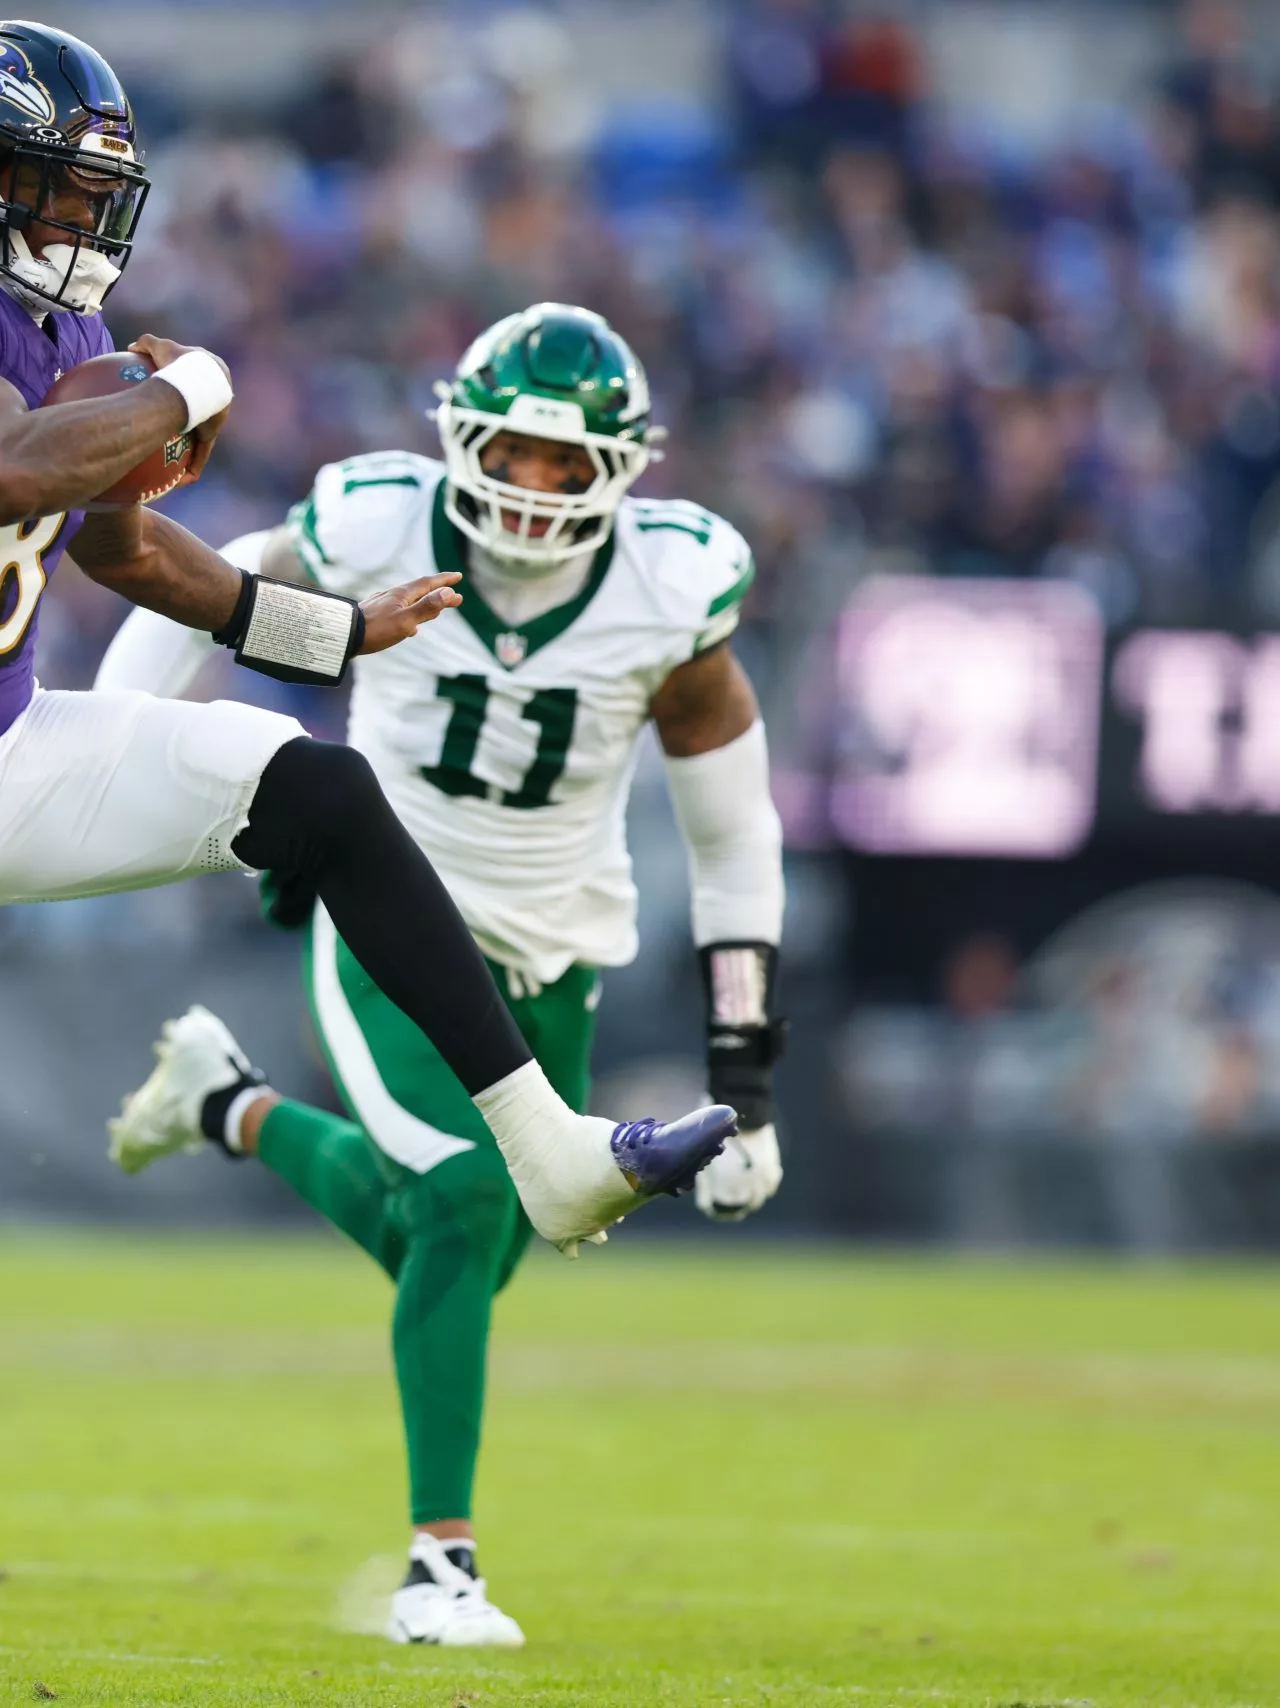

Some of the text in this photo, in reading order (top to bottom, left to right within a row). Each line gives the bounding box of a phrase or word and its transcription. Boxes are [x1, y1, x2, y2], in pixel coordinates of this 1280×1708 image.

[29, 134, 67, 146] OAKLEY
[99, 136, 129, 154] RAVENS
[418, 673, 578, 809] 11
